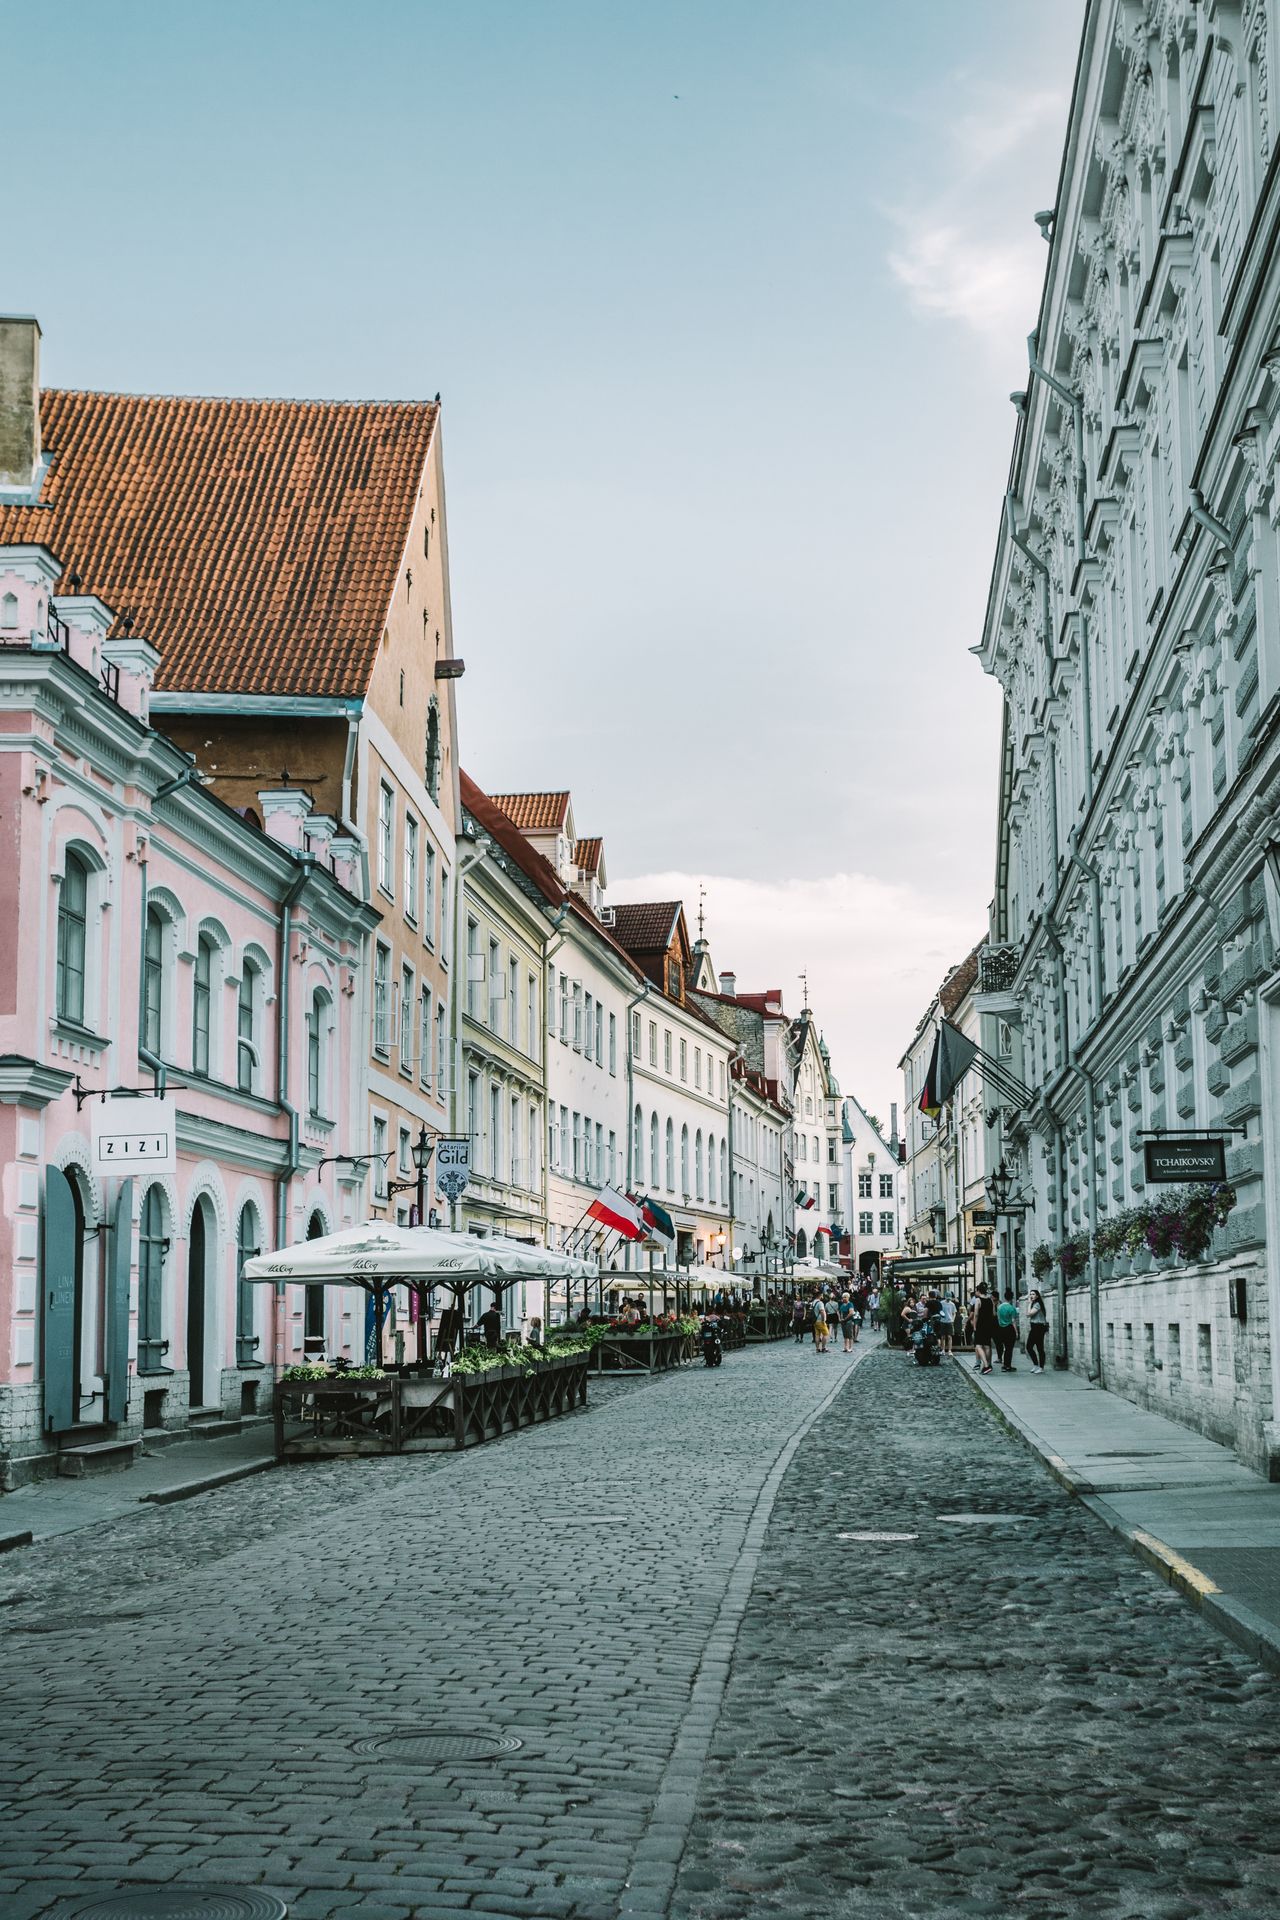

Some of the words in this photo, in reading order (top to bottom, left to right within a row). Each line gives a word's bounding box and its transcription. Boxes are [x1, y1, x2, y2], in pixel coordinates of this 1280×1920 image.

[106, 1140, 160, 1154] ZIZI
[437, 1149, 469, 1165] Gild
[1153, 1157, 1216, 1167] TCHAIKOVSKY
